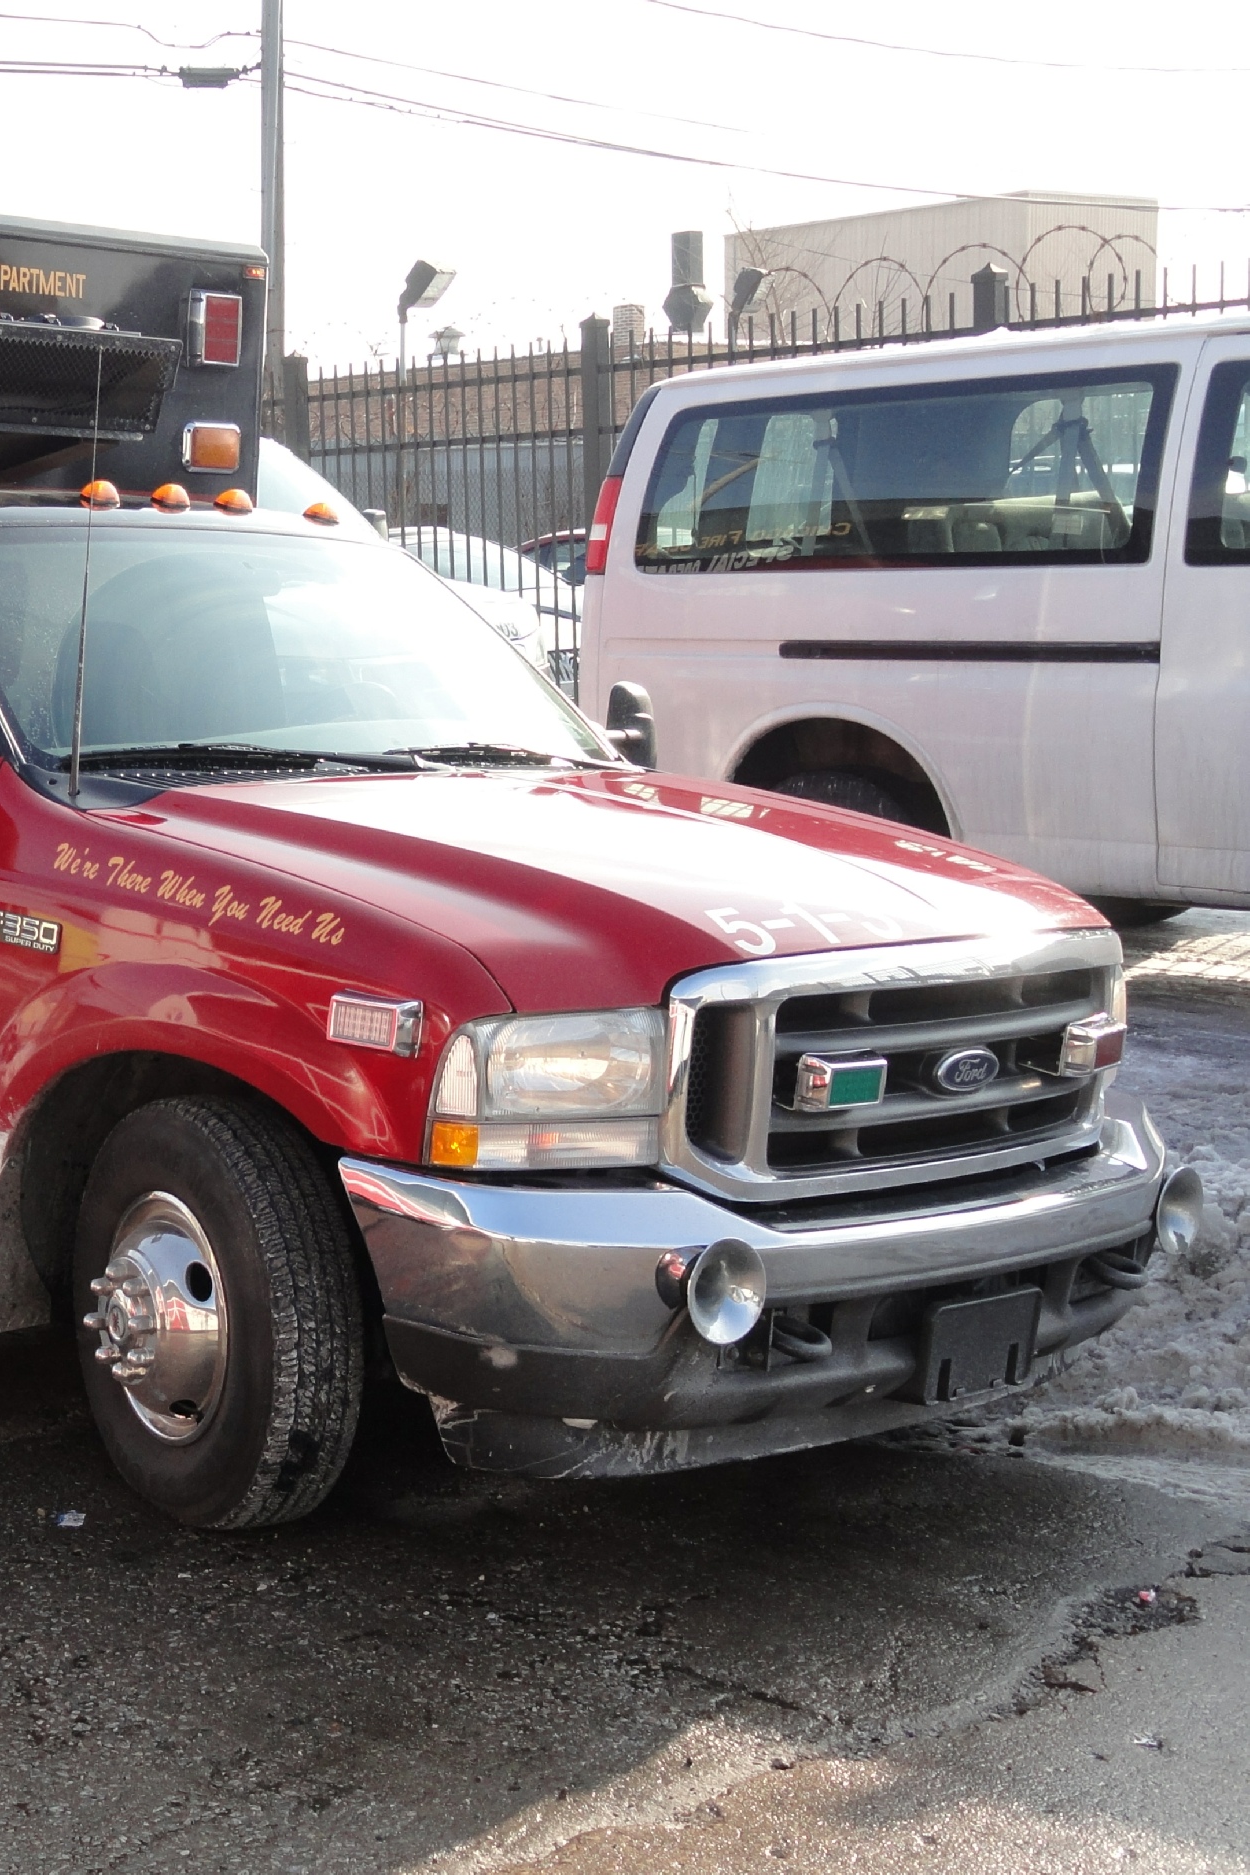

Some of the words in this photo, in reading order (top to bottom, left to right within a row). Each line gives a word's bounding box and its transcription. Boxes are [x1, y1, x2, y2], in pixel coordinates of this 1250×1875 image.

[53, 842, 100, 880] We're
[106, 856, 152, 893] There
[157, 869, 206, 908] When
[208, 884, 250, 927] You
[256, 896, 313, 935] Need
[311, 912, 345, 945] Us
[5, 934, 31, 947] SUPER
[33, 941, 55, 952] DUTY
[954, 1058, 988, 1083] Ford
